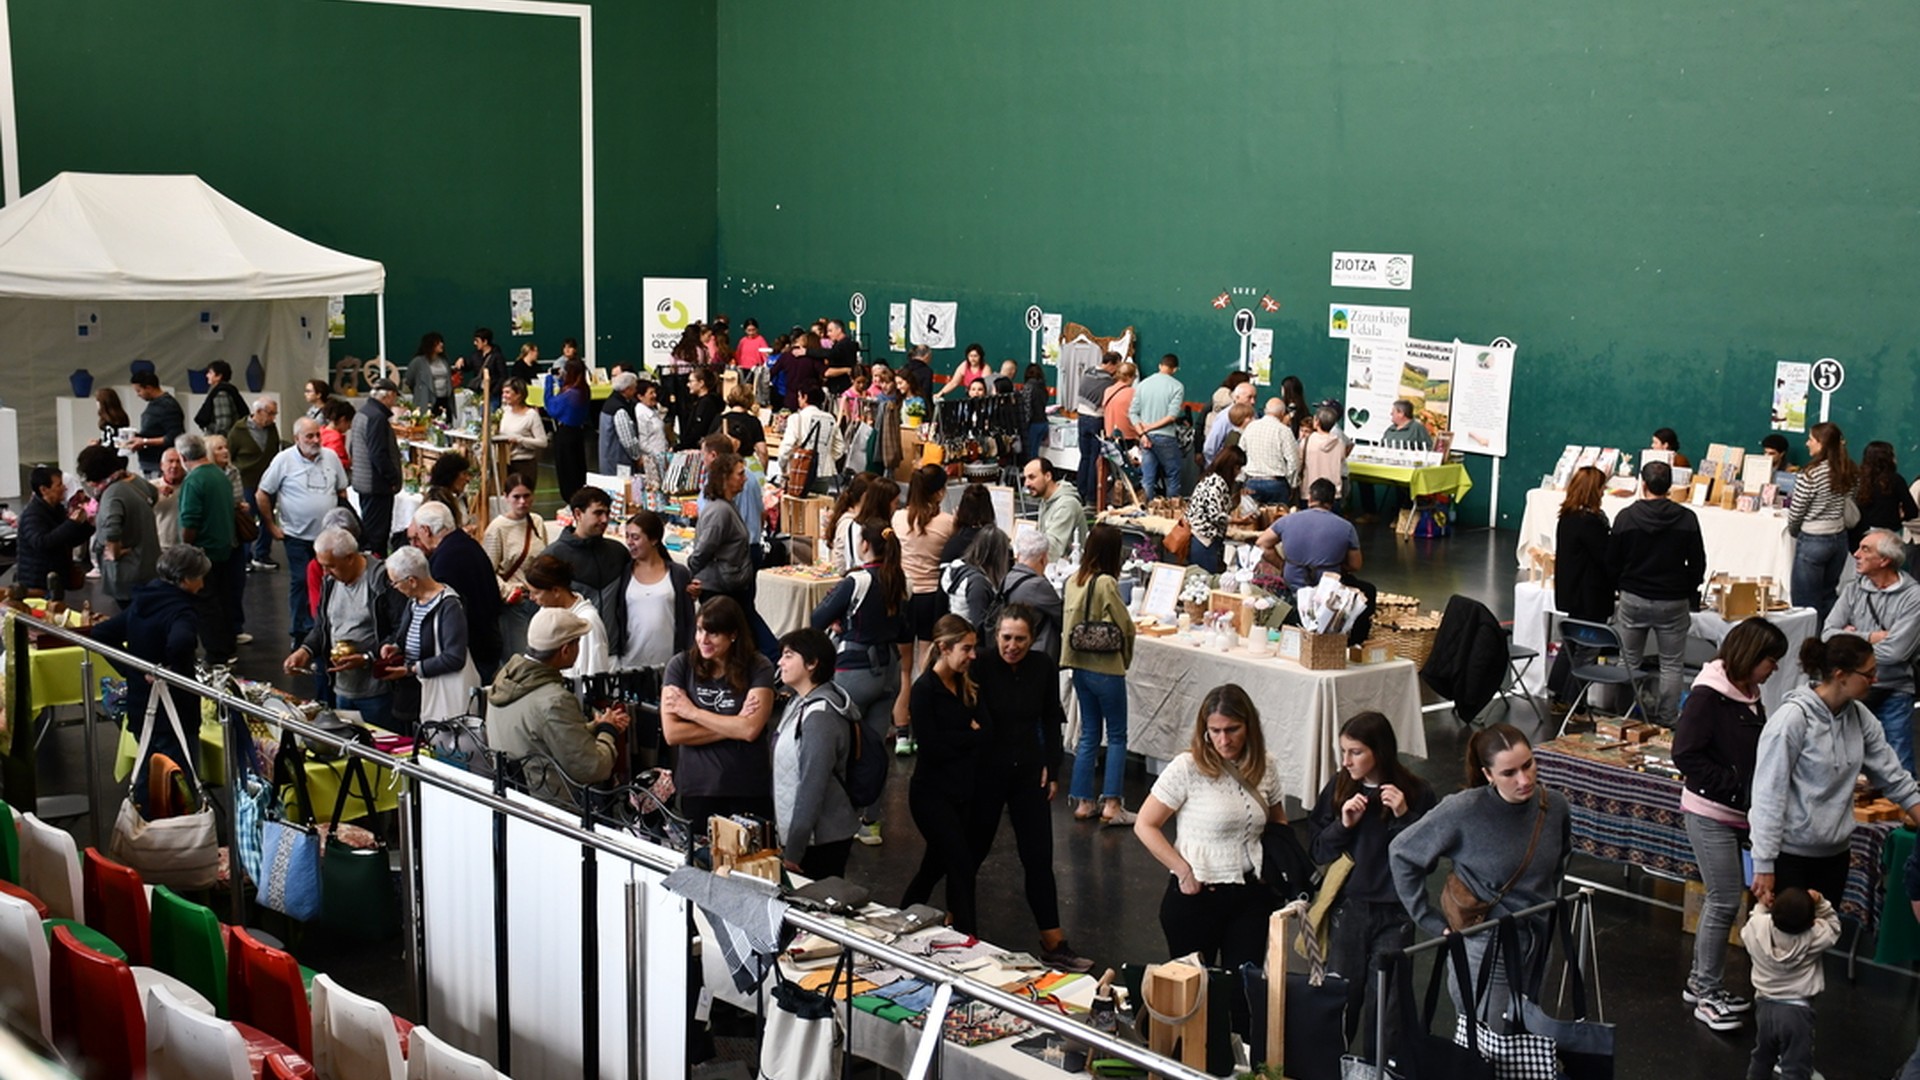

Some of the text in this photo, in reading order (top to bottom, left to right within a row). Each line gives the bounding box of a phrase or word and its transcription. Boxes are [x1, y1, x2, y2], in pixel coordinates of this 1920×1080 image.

[1334, 258, 1377, 272] ZIOTZA
[854, 296, 863, 313] 9
[926, 313, 940, 334] R
[1029, 310, 1040, 328] 8
[1238, 313, 1250, 334] 7
[1350, 310, 1408, 327] Zizurkilgo
[1350, 323, 1383, 337] Udala
[1817, 363, 1837, 388] 5
